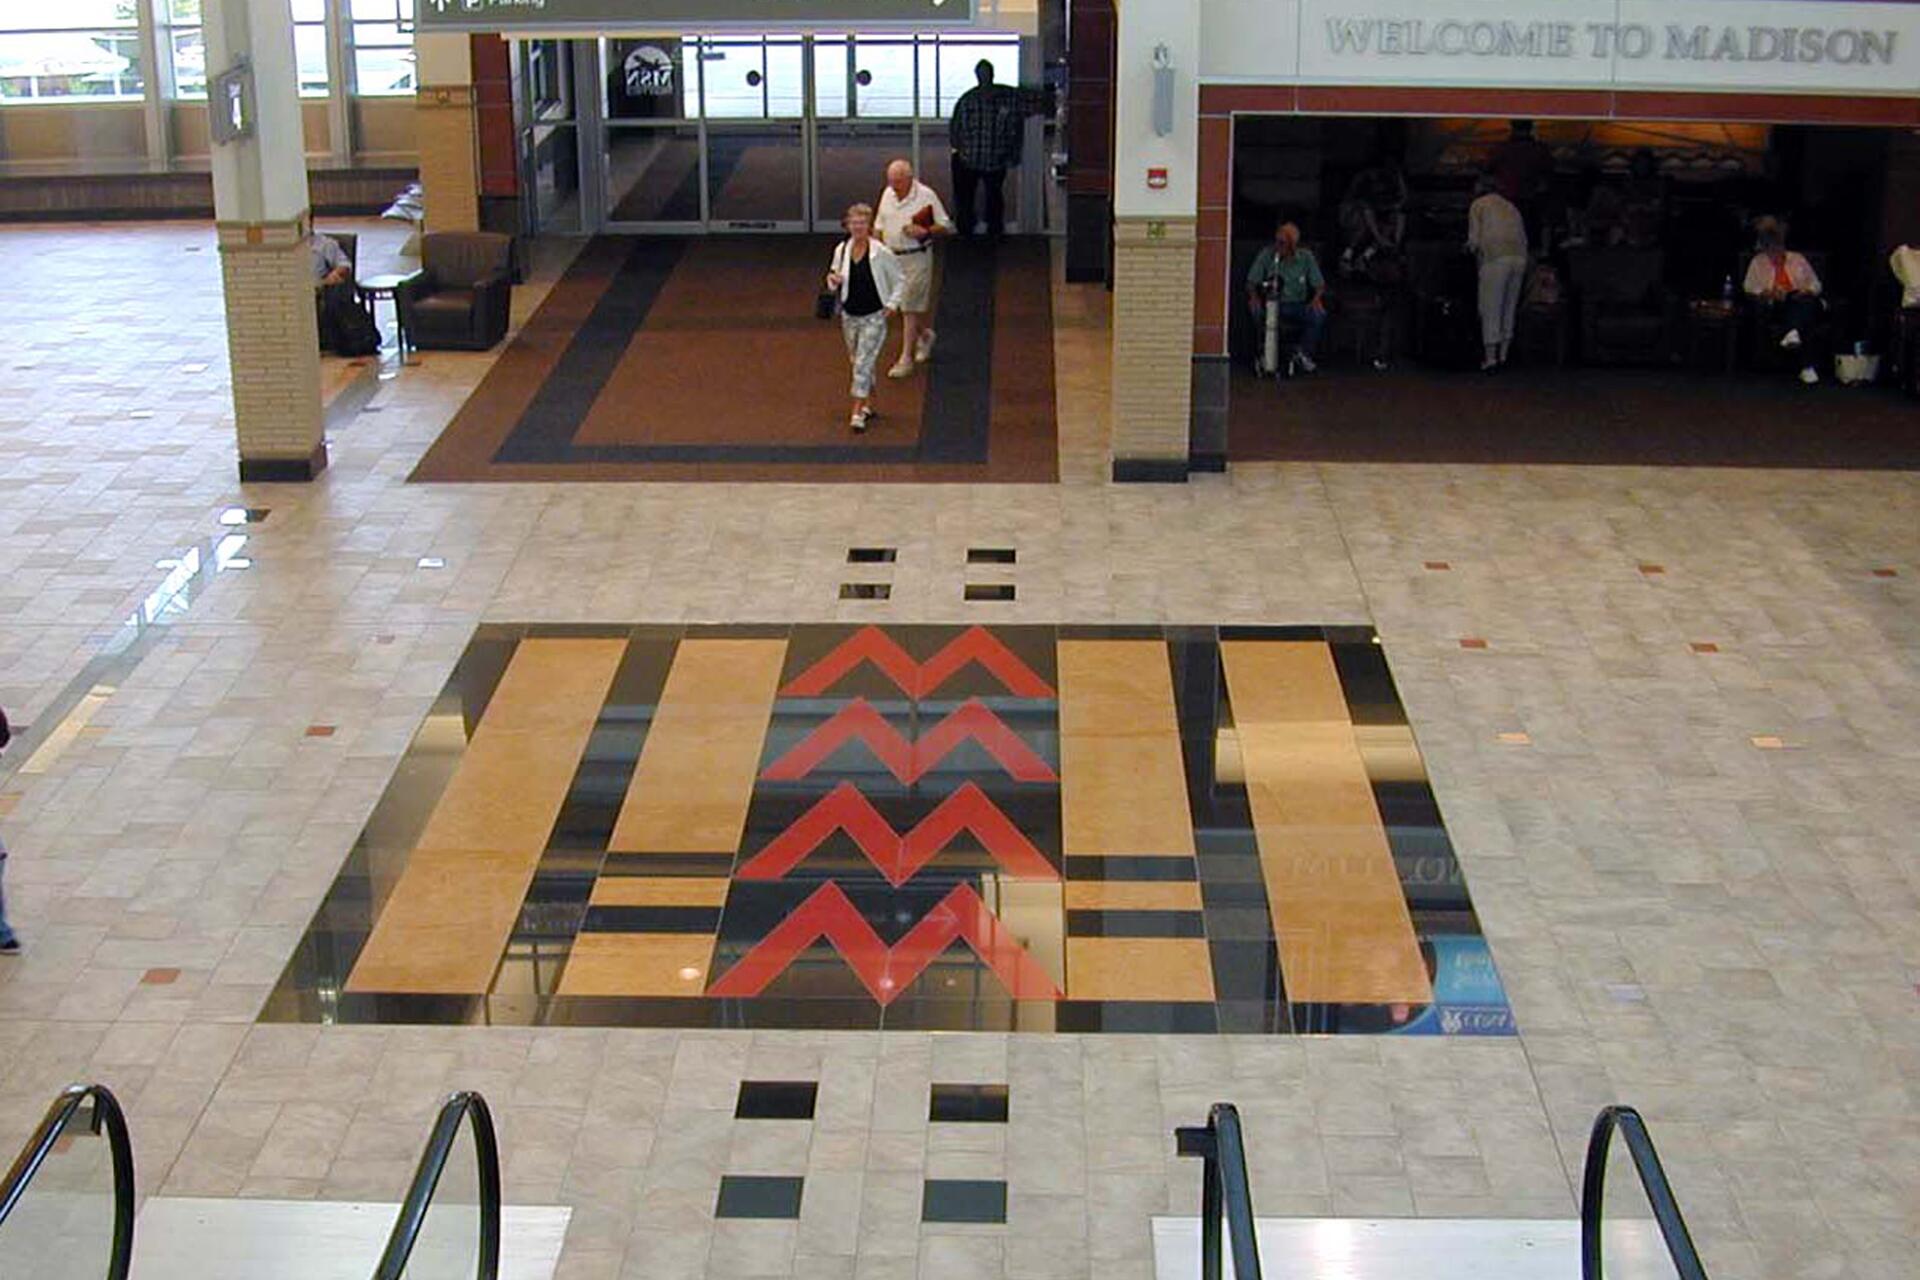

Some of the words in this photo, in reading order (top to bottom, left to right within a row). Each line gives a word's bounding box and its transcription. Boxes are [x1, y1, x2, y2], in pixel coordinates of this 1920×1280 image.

[1326, 18, 1574, 58] WELCOME
[1586, 23, 1652, 60] TO
[1663, 24, 1899, 64] MADISON
